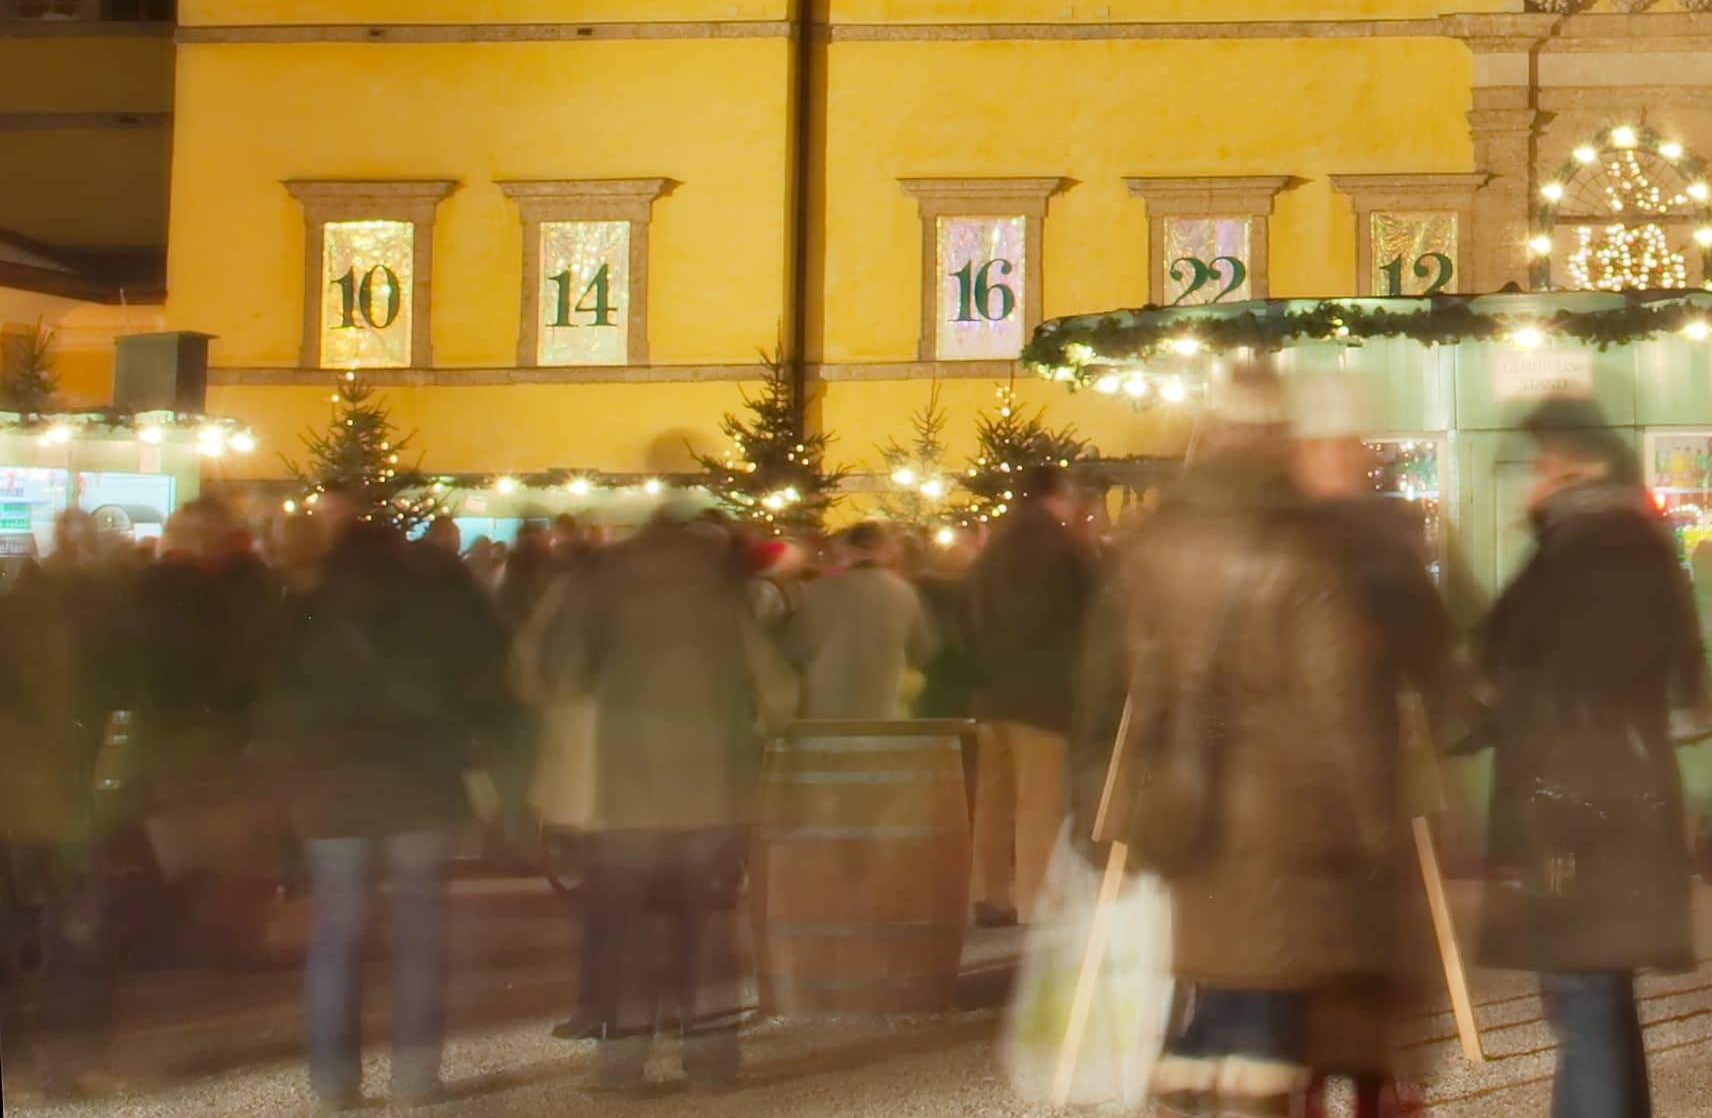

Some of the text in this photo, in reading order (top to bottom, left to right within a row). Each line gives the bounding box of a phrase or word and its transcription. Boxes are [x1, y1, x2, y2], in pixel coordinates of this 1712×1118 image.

[330, 264, 400, 329] 10
[546, 263, 617, 327] 14
[949, 258, 1015, 322] 16
[1170, 256, 1245, 306] 22
[1380, 252, 1453, 297] 12
